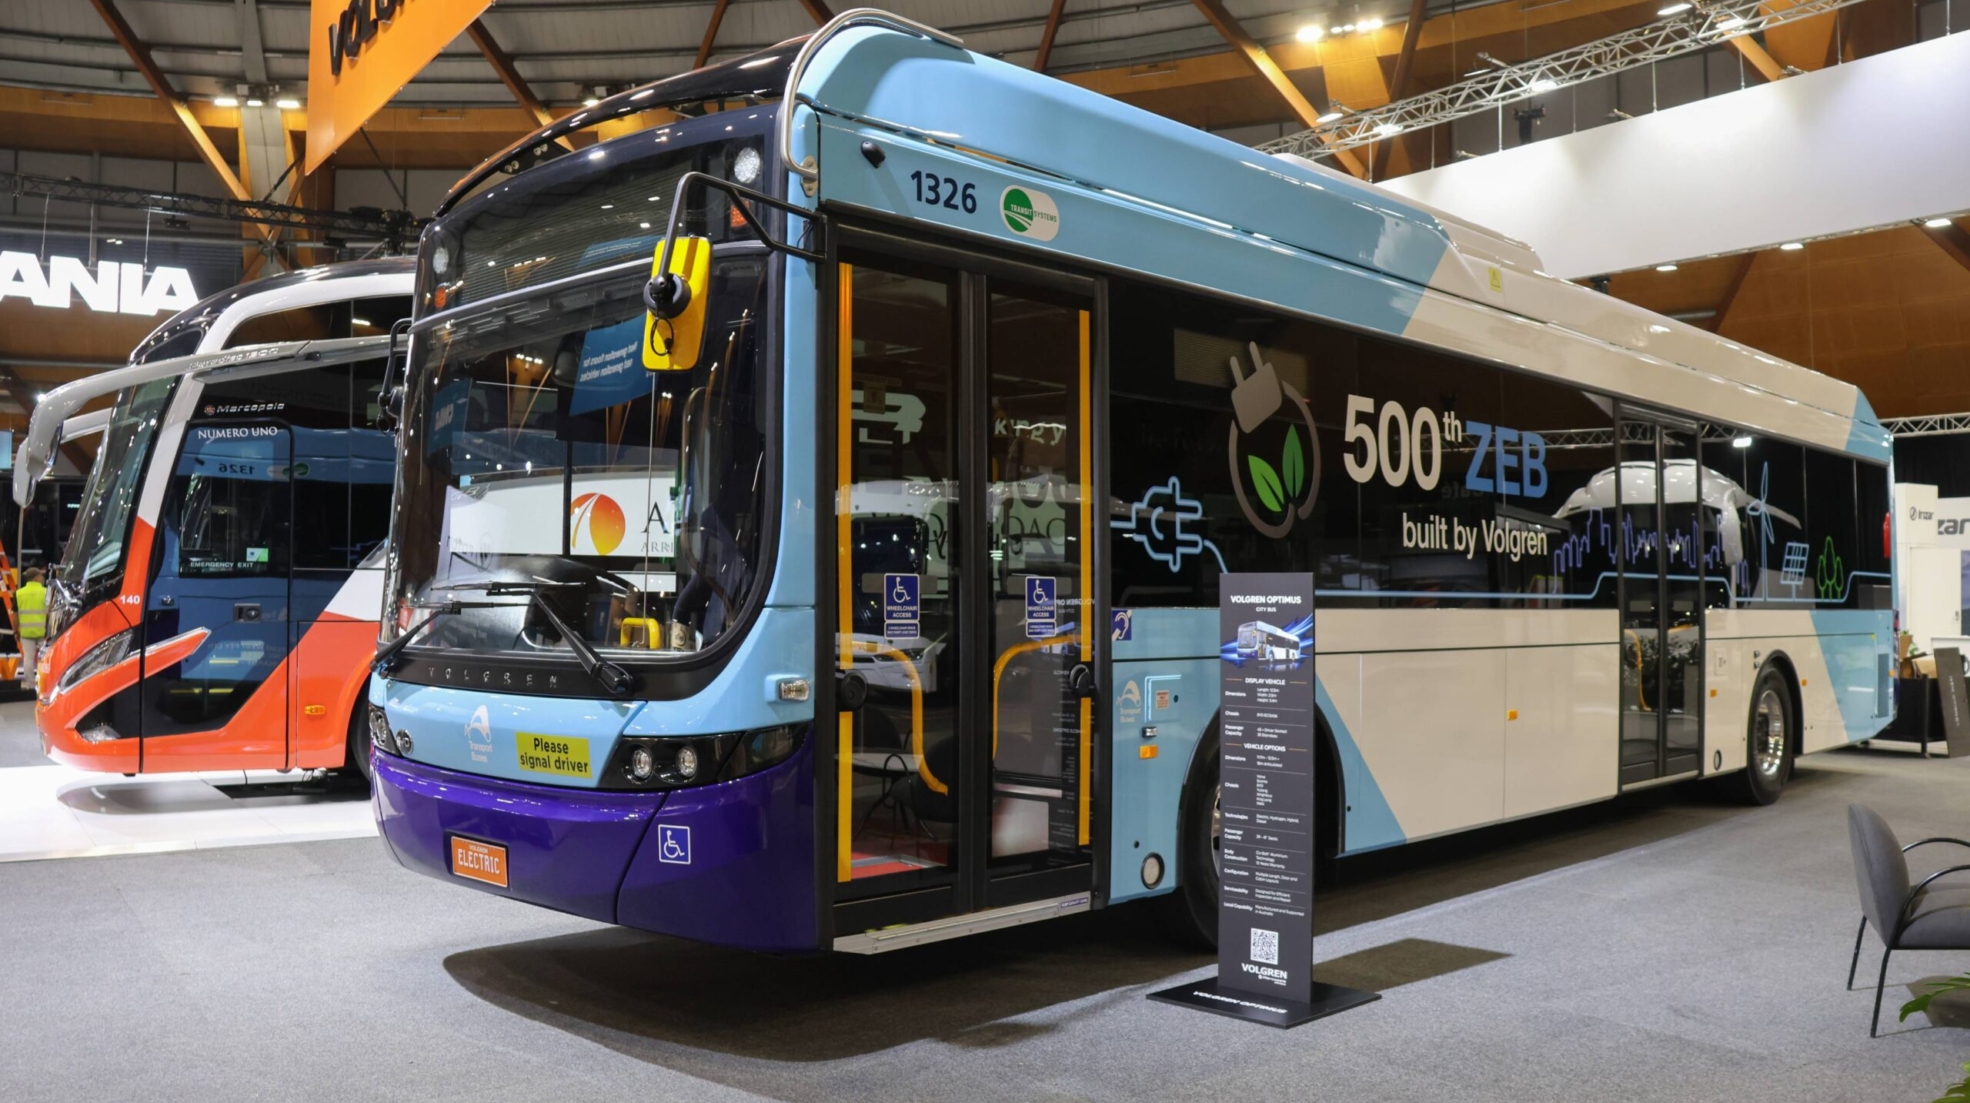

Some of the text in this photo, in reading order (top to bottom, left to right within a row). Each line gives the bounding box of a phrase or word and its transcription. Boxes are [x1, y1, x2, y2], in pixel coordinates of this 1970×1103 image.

[910, 170, 977, 214] 1326
[1010, 203, 1057, 223] TRANSIT SYSTEMS
[217, 402, 285, 413] Marcopolo
[198, 426, 278, 439] NUMERO UNO
[1465, 420, 1548, 498] ZEB
[1402, 512, 1547, 562] built by Volgren
[120, 595, 140, 605] 140
[1230, 595, 1302, 604] VOLGREN OPTIMUS
[429, 667, 557, 688] VOLGREN
[469, 740, 493, 753] Transport
[533, 737, 569, 754] Please
[1244, 742, 1286, 752] VEHICLE OPTIONS
[471, 752, 488, 763] Buses
[520, 752, 588, 773] signal driver
[457, 848, 500, 874] ELECTRIC
[1241, 962, 1287, 979] VOLGREN
